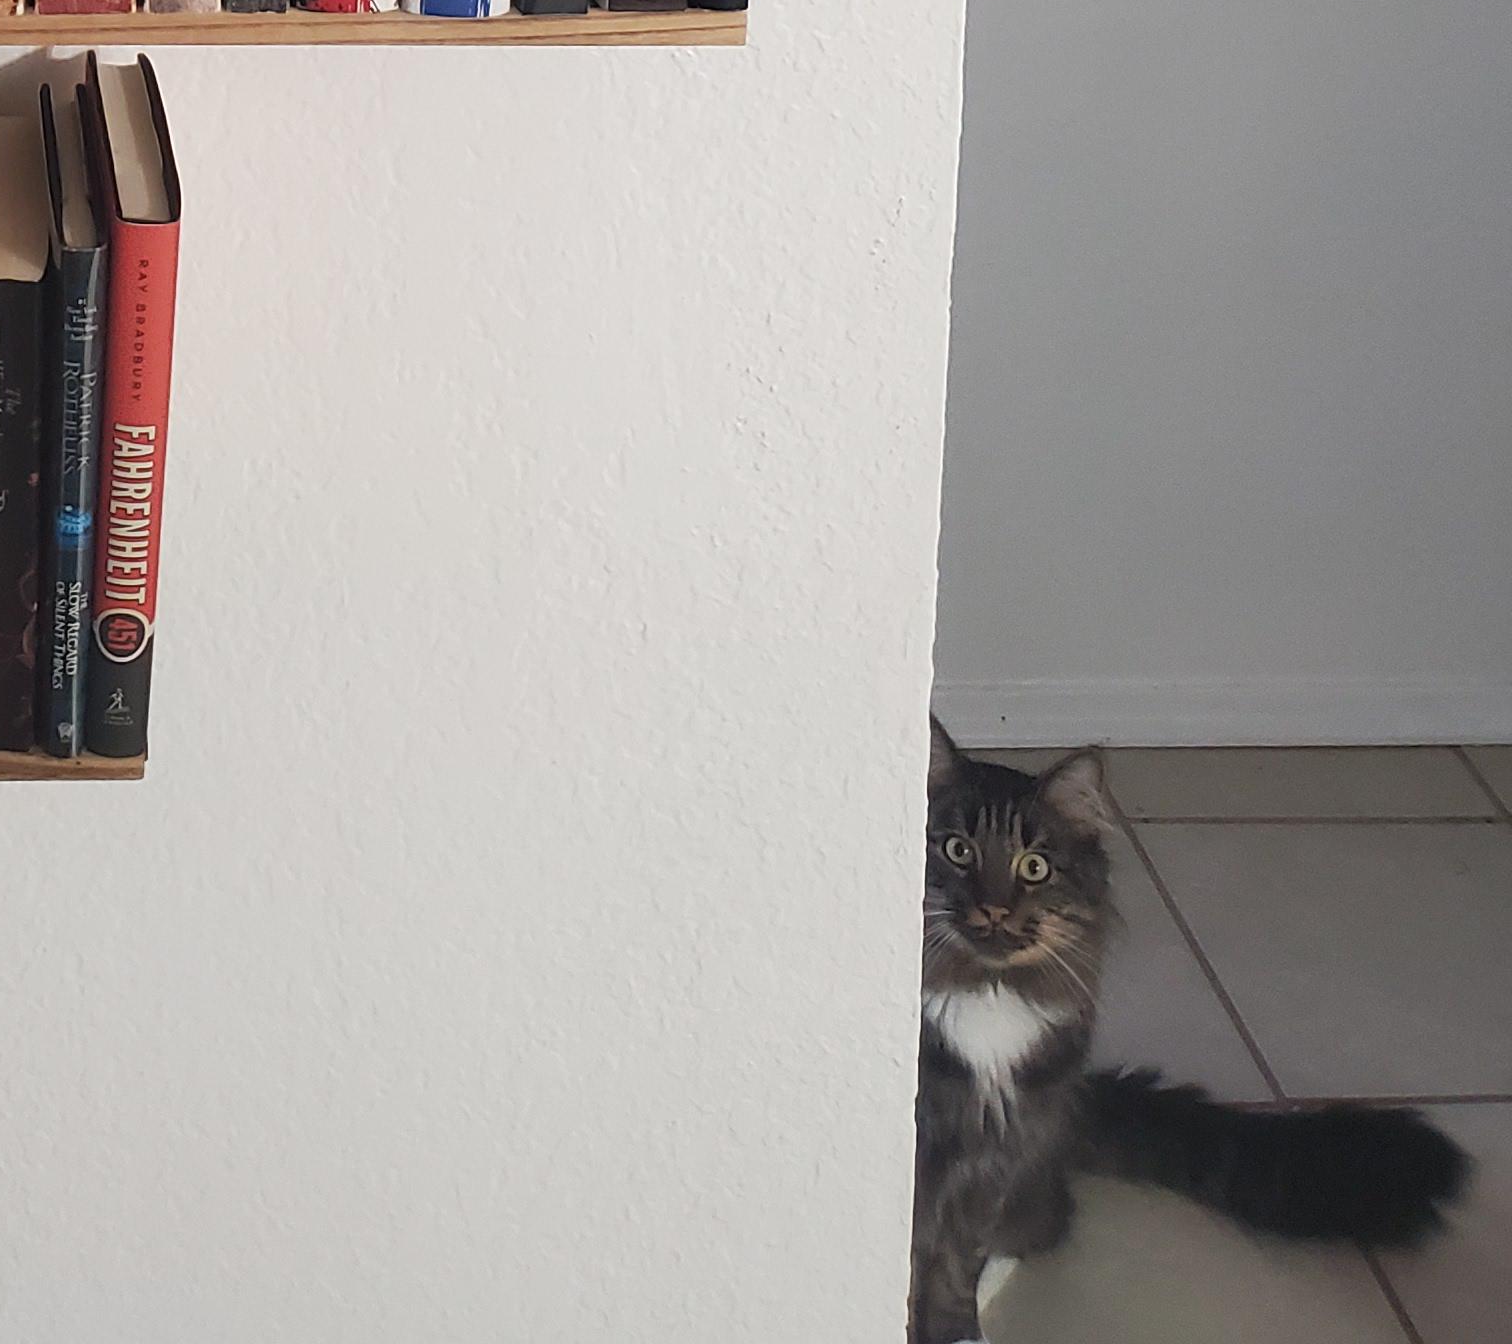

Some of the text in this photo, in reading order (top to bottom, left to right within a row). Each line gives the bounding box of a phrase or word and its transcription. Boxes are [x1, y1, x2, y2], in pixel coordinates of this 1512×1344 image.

[132, 259, 148, 402] RAY BRADBURY
[105, 423, 156, 650] FAHRENHEIT 451
